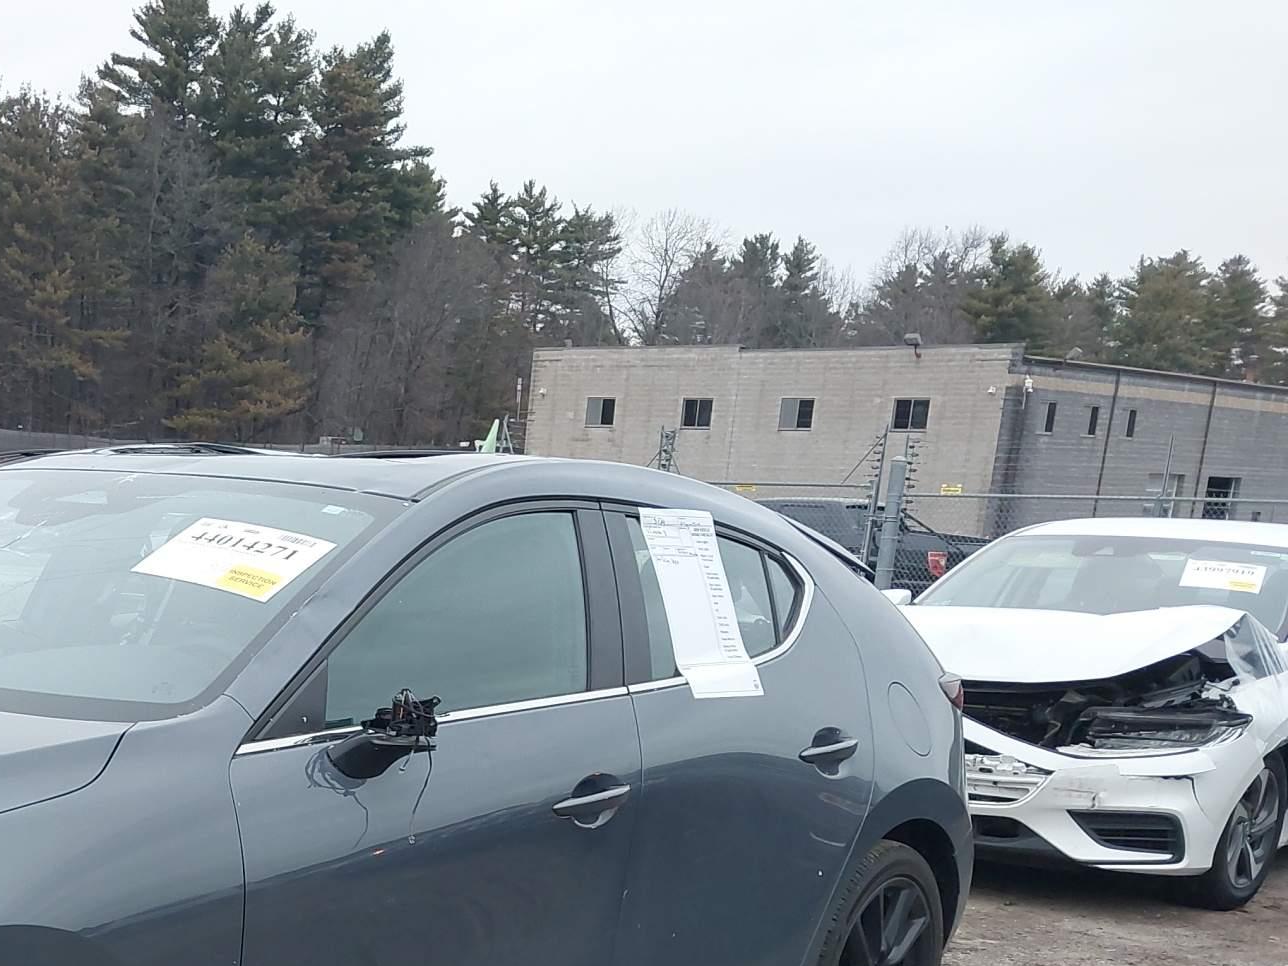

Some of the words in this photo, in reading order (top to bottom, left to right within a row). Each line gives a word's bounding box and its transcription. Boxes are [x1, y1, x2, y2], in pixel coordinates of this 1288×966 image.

[192, 531, 299, 560] 44014271
[228, 577, 265, 589] SERVICE
[229, 569, 277, 586] INSPECTION
